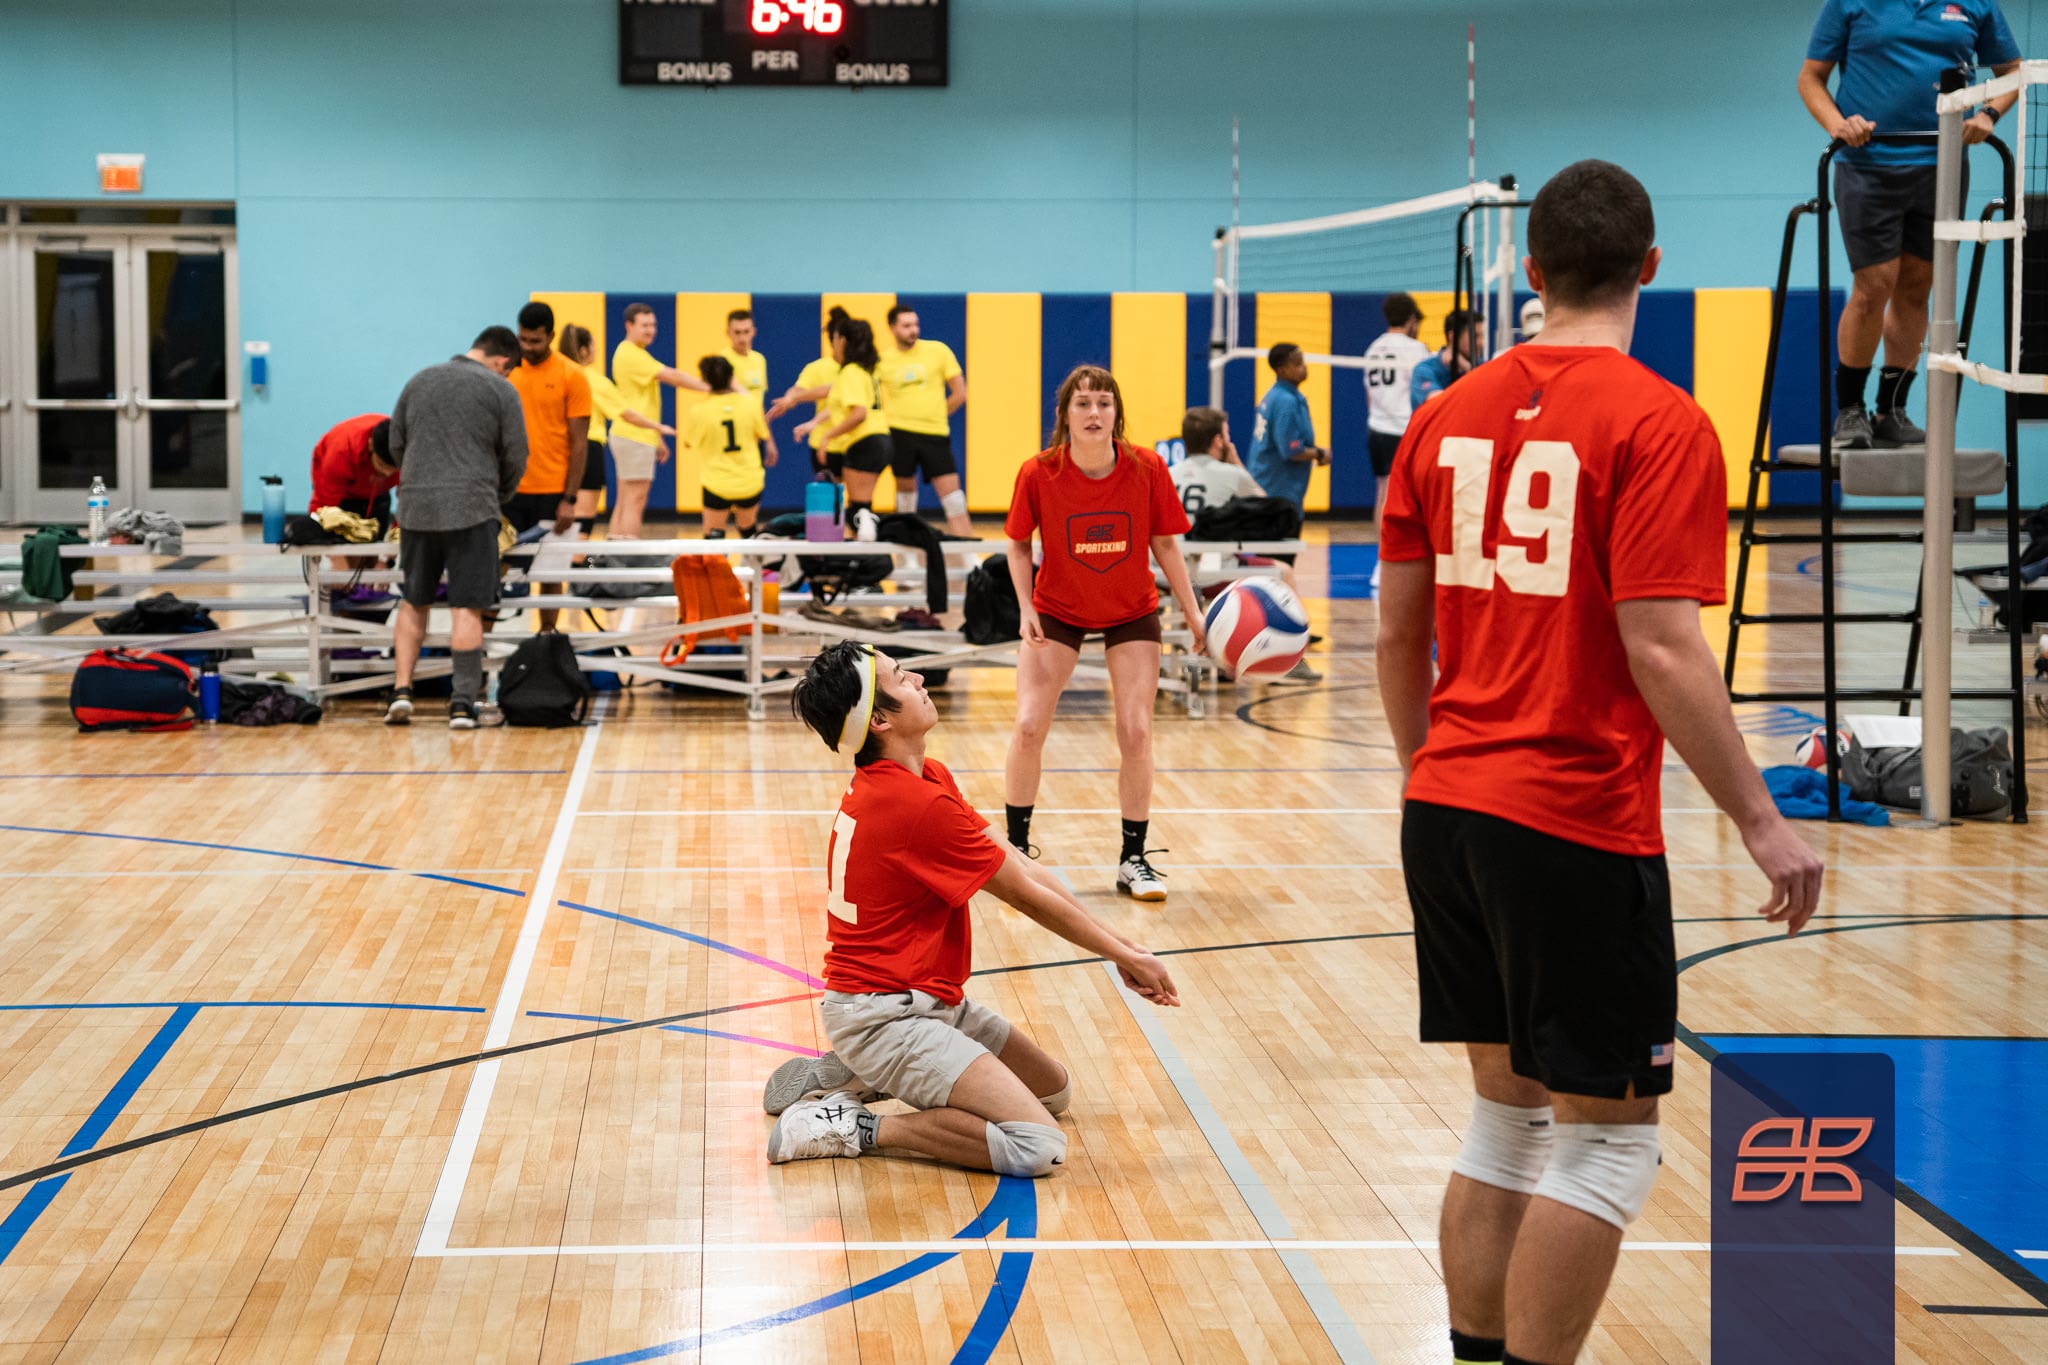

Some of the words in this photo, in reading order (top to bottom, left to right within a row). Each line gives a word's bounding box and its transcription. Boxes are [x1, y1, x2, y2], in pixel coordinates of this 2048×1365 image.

[752, 50, 799, 70] PER
[657, 62, 733, 82] BONUS
[835, 63, 910, 82] BONUS
[721, 419, 742, 453] 1
[1435, 436, 1581, 598] 19
[1075, 541, 1127, 554] SPORTSKIND
[827, 809, 858, 925] 1
